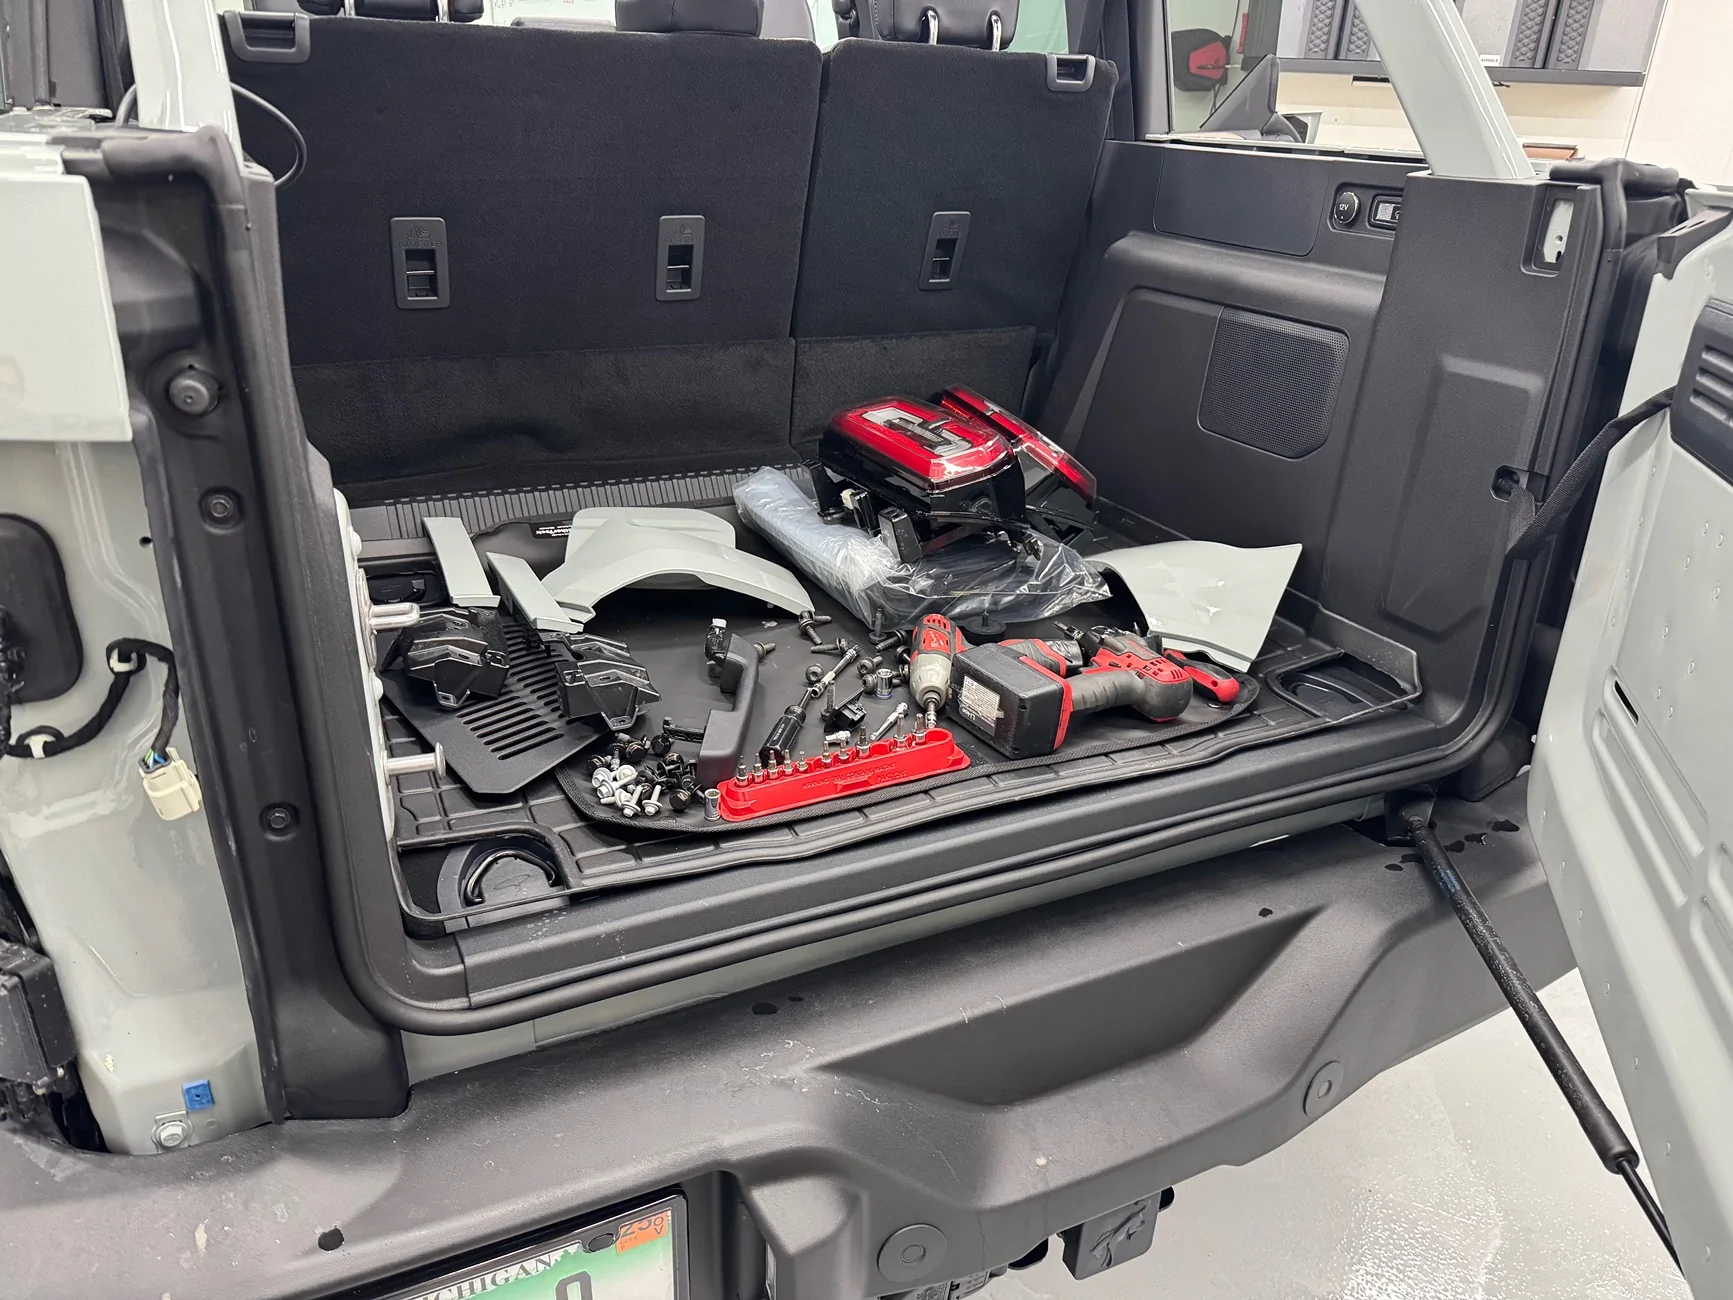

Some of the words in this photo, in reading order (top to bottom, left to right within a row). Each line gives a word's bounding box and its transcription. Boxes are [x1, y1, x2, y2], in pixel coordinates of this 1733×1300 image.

[1339, 203, 1350, 211] 12V
[653, 1216, 665, 1236] OV
[422, 1254, 553, 1300] CHIGAN
